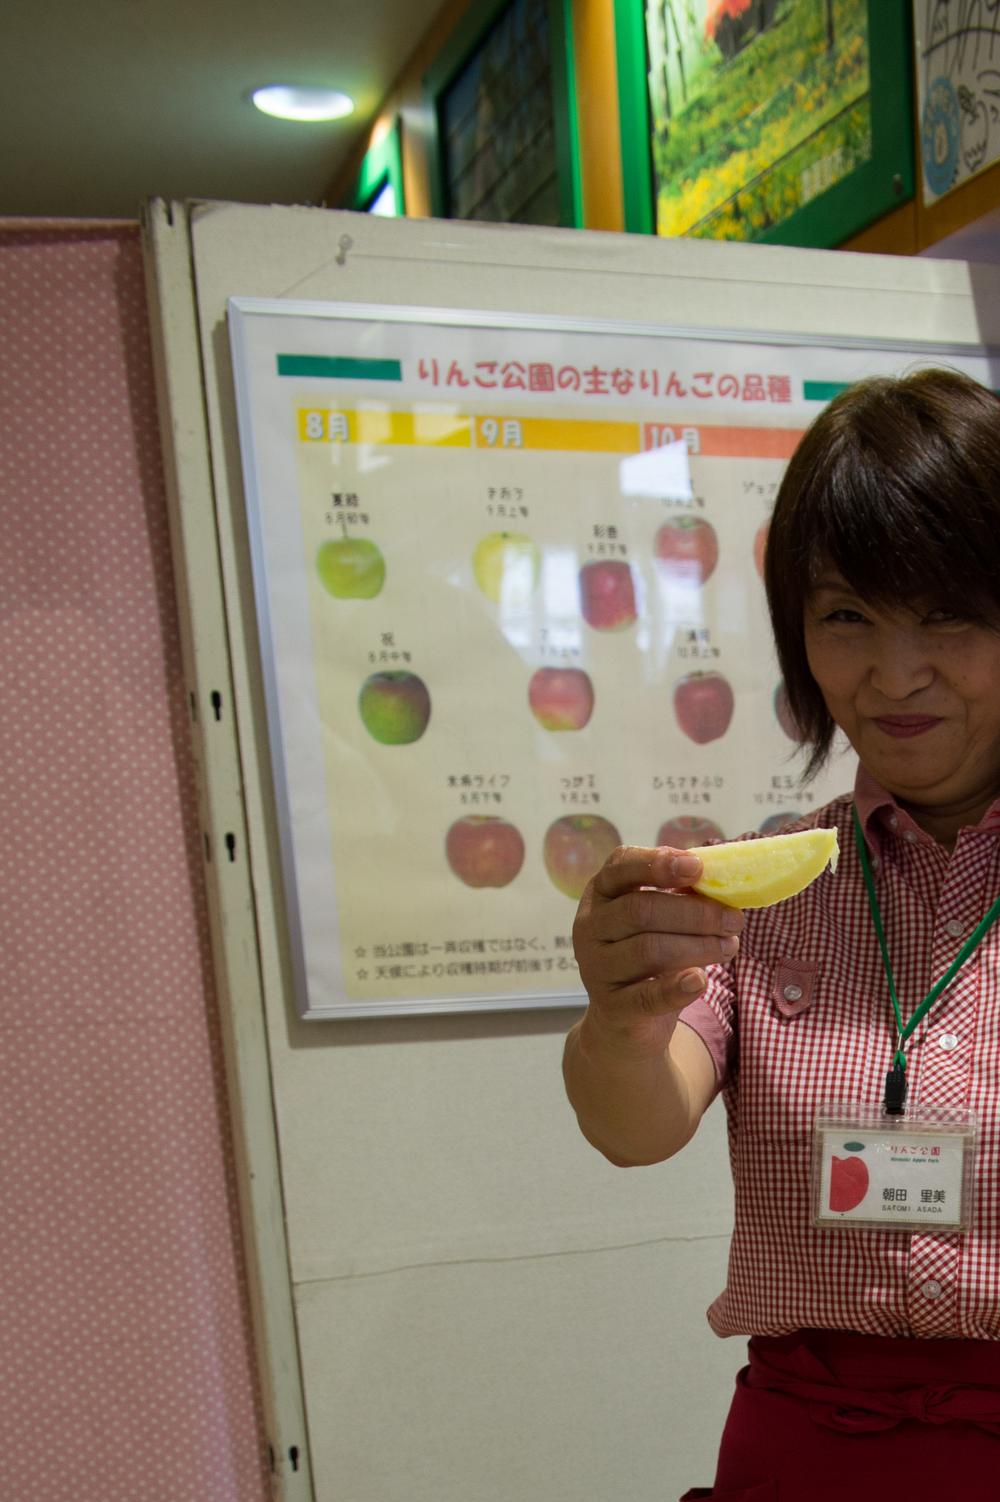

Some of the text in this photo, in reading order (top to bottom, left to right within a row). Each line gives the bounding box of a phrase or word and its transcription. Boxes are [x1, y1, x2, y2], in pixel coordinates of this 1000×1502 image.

[418, 357, 794, 404] りんご公園の主なりんごの品種
[305, 412, 349, 442] 8月
[480, 420, 524, 449] 9月
[881, 1204, 911, 1212] SATOMI
[882, 1188, 946, 1203] 朝田 里美
